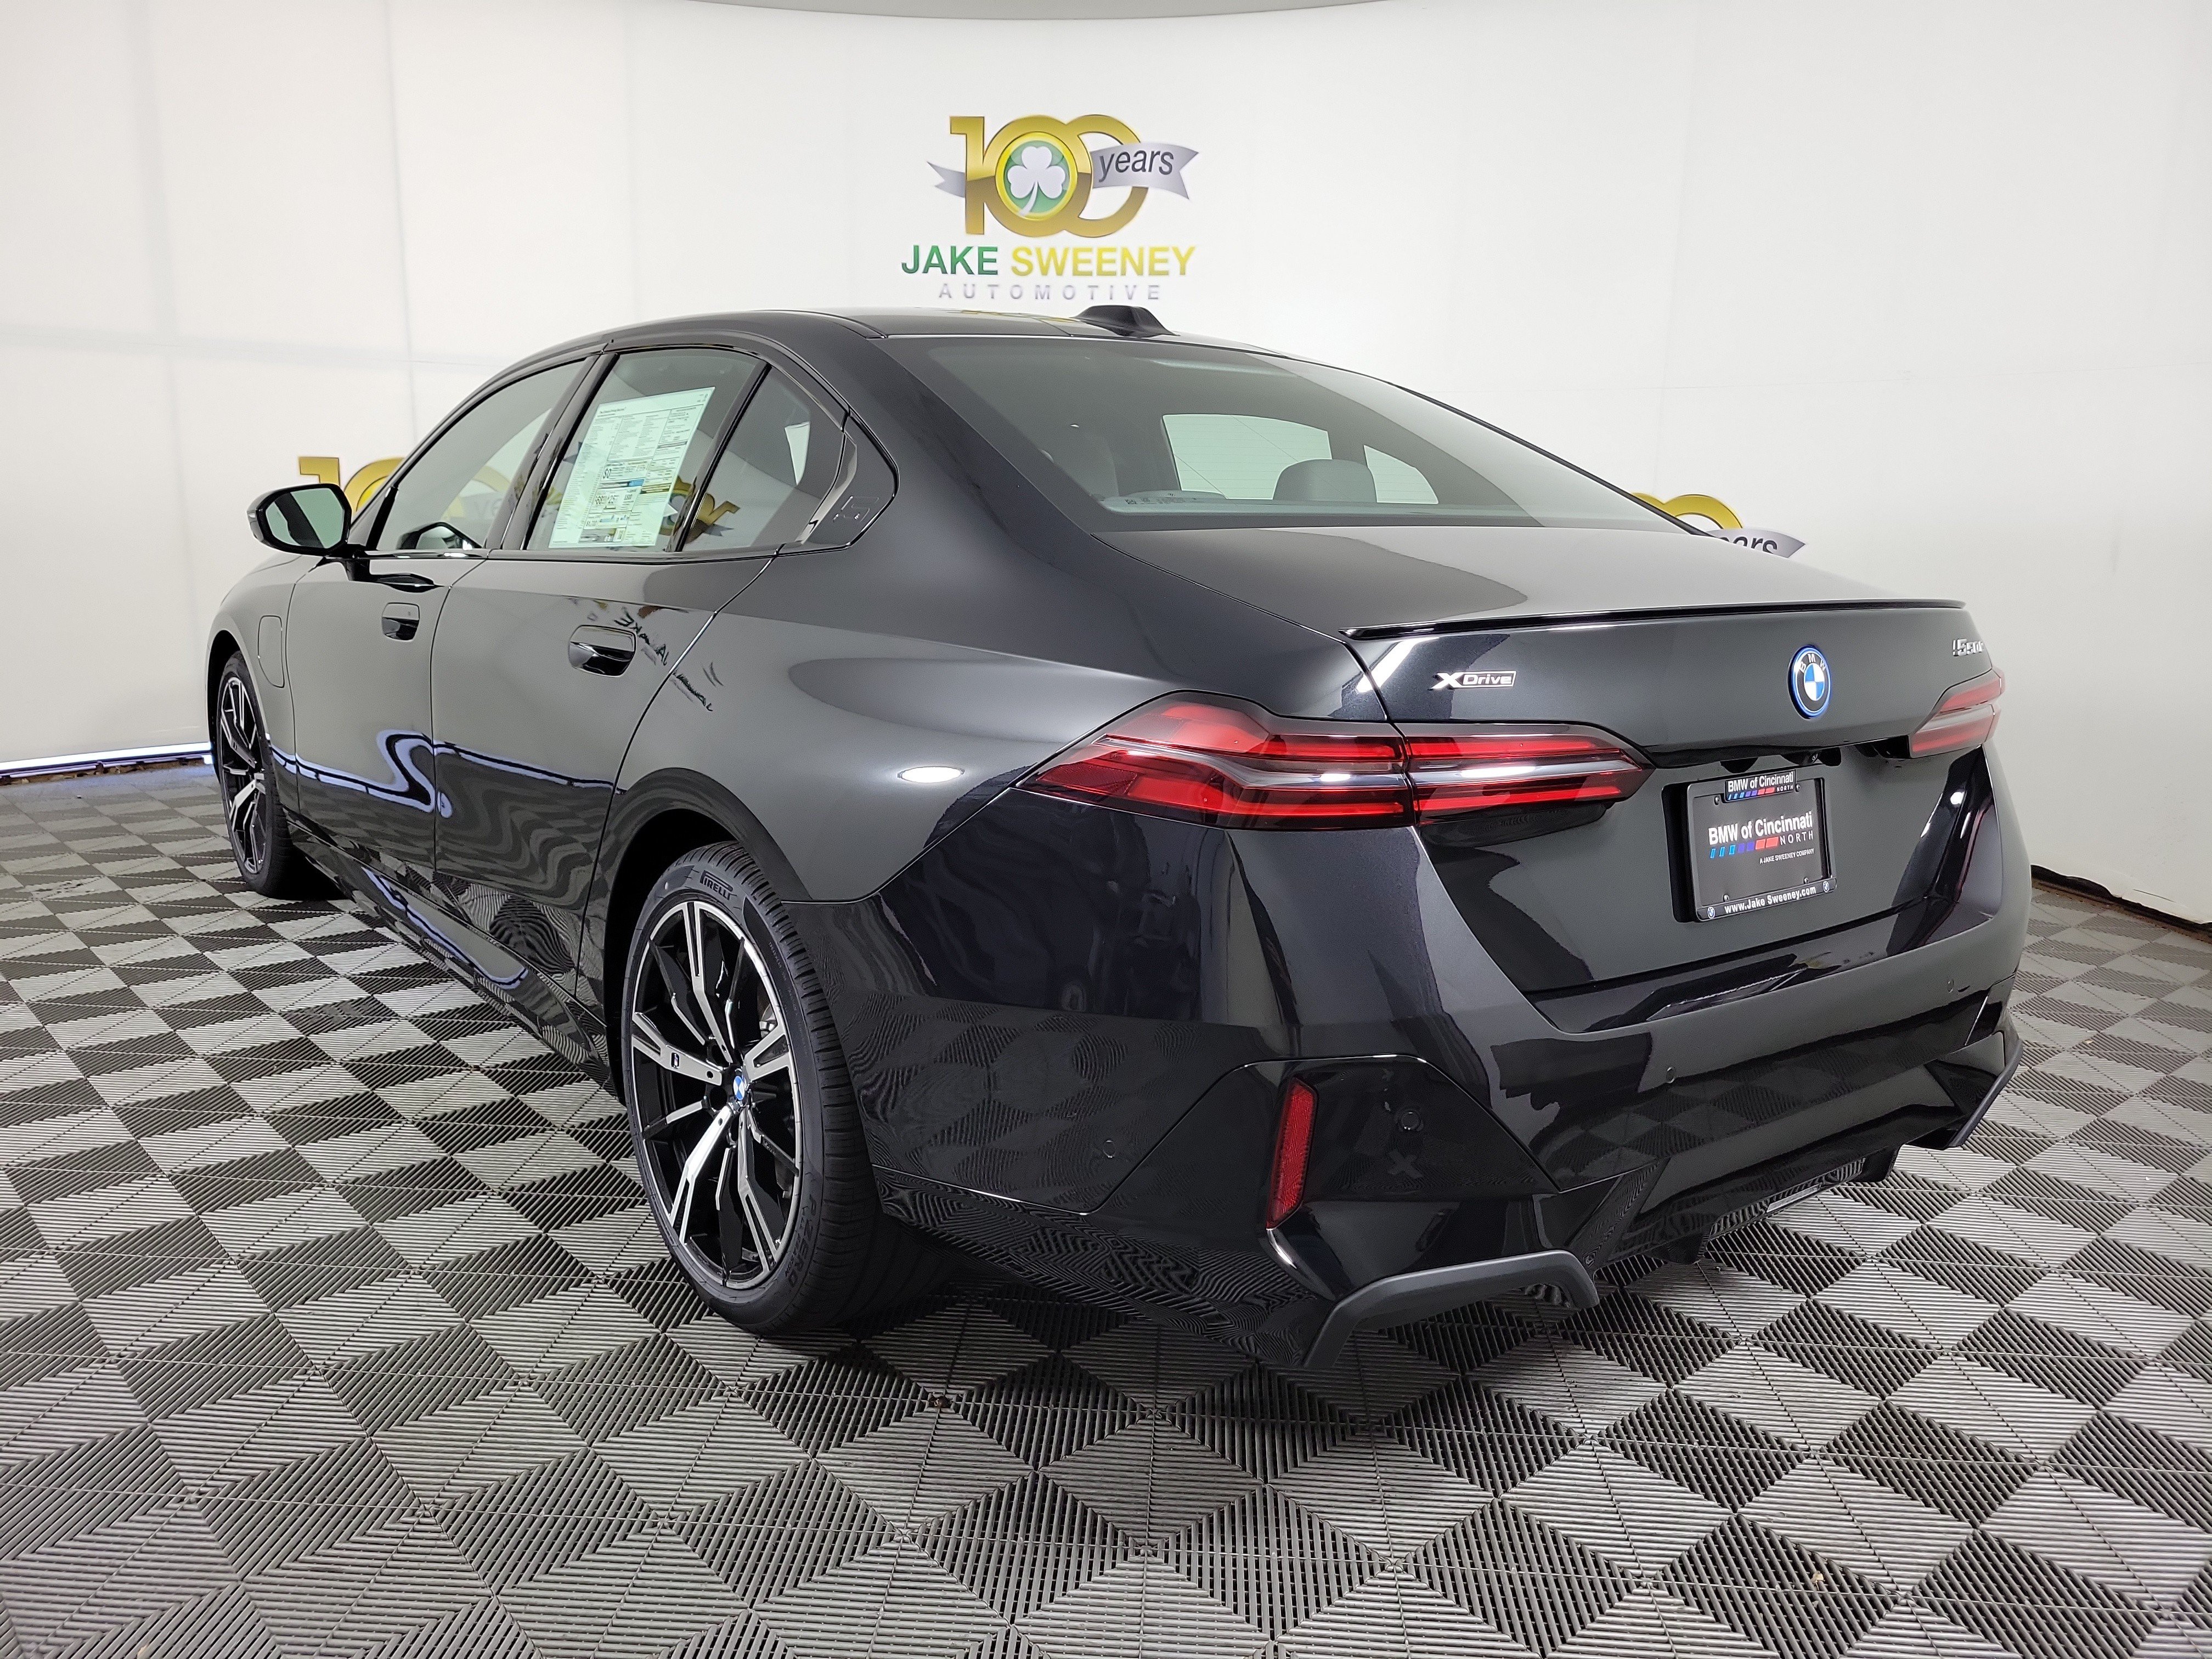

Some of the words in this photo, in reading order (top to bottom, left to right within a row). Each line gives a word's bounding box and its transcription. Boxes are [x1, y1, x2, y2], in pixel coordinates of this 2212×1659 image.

[950, 114, 1148, 238] 100
[1098, 149, 1174, 183] years
[901, 245, 998, 275] JAKE
[1011, 246, 1196, 276] SWEENEY
[938, 283, 1161, 301] AUTOMOTIVE
[1799, 653, 1826, 673] BMW
[1728, 778, 1748, 792] BMW
[1750, 777, 1758, 788] of
[1759, 771, 1794, 787] Cincinnati
[1776, 784, 1793, 792] NORTH
[1708, 823, 1739, 845] BMW
[1741, 821, 1753, 839] of
[1755, 810, 1814, 837] Cincinnati
[1780, 830, 1814, 845] NORTH
[1763, 855, 1775, 864] JAKE
[1775, 851, 1796, 862] SWEENEY
[1796, 848, 1815, 857] COMPANY
[699, 870, 733, 900] PIRELLI
[1767, 885, 1816, 905] Sweeney.com
